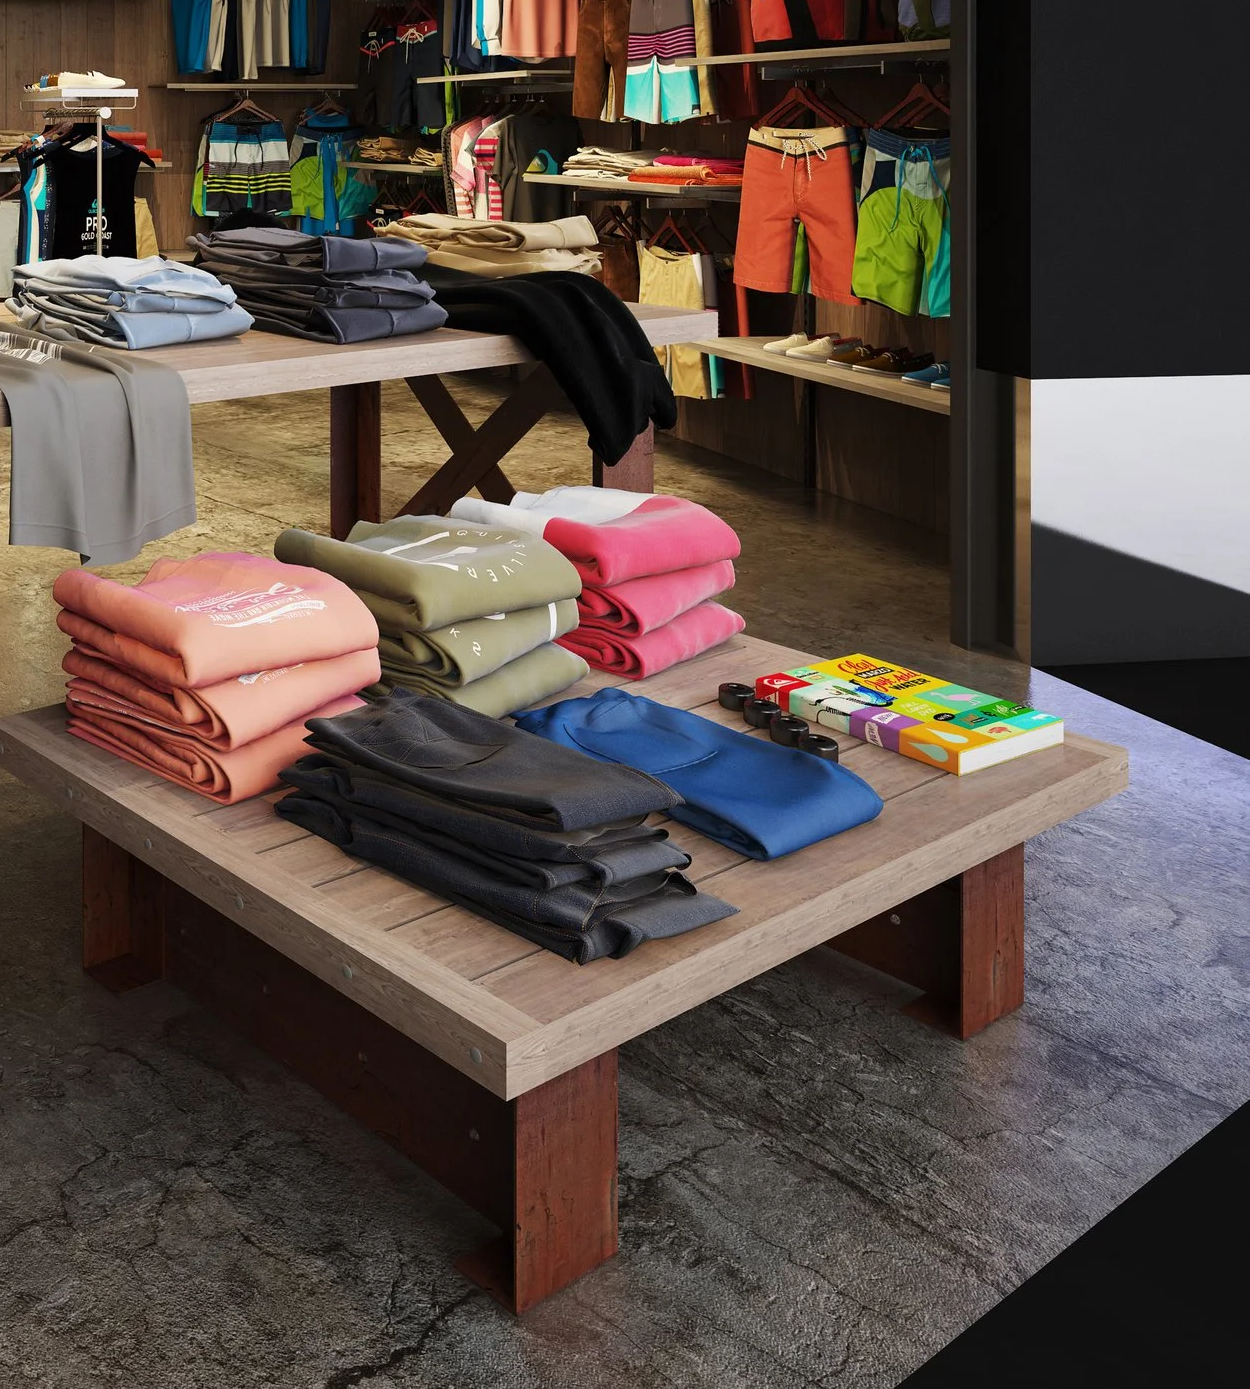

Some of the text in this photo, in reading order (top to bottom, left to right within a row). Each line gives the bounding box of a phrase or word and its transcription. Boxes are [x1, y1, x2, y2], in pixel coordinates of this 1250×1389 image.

[86, 215, 108, 231] PRO
[81, 231, 112, 241] GOLD OAST
